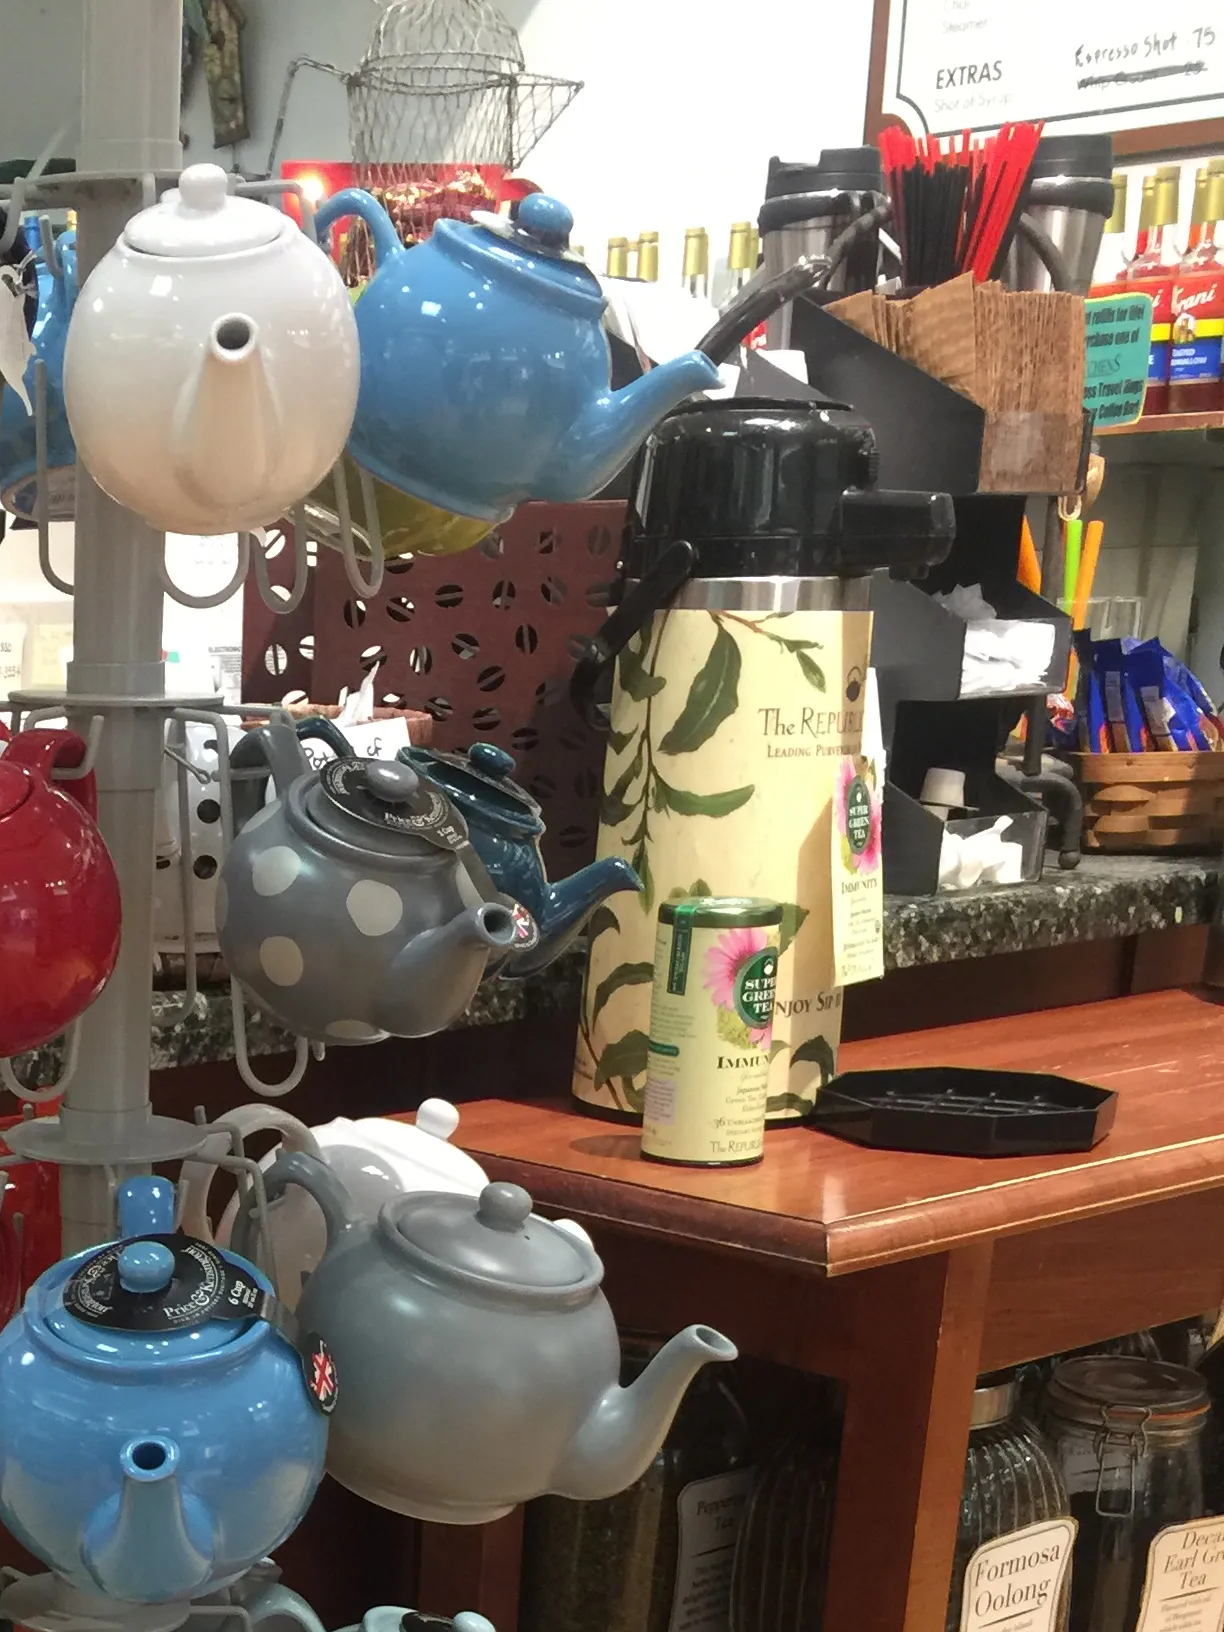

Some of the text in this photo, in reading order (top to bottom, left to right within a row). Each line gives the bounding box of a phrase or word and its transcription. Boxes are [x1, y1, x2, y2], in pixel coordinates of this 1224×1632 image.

[1144, 32, 1177, 57] Shot
[936, 61, 1003, 89] EXTRAS
[757, 707, 796, 736] The
[767, 744, 811, 758] LEADING
[230, 1280, 246, 1298] Cup
[163, 1301, 194, 1318] Price
[191, 1289, 210, 1306] &
[1182, 1530, 1224, 1550] Deca
[975, 1544, 1061, 1588] Formosa
[1163, 1549, 1199, 1574] Earl
[1180, 1571, 1207, 1590] Tea
[974, 1578, 1052, 1618] Oolong
